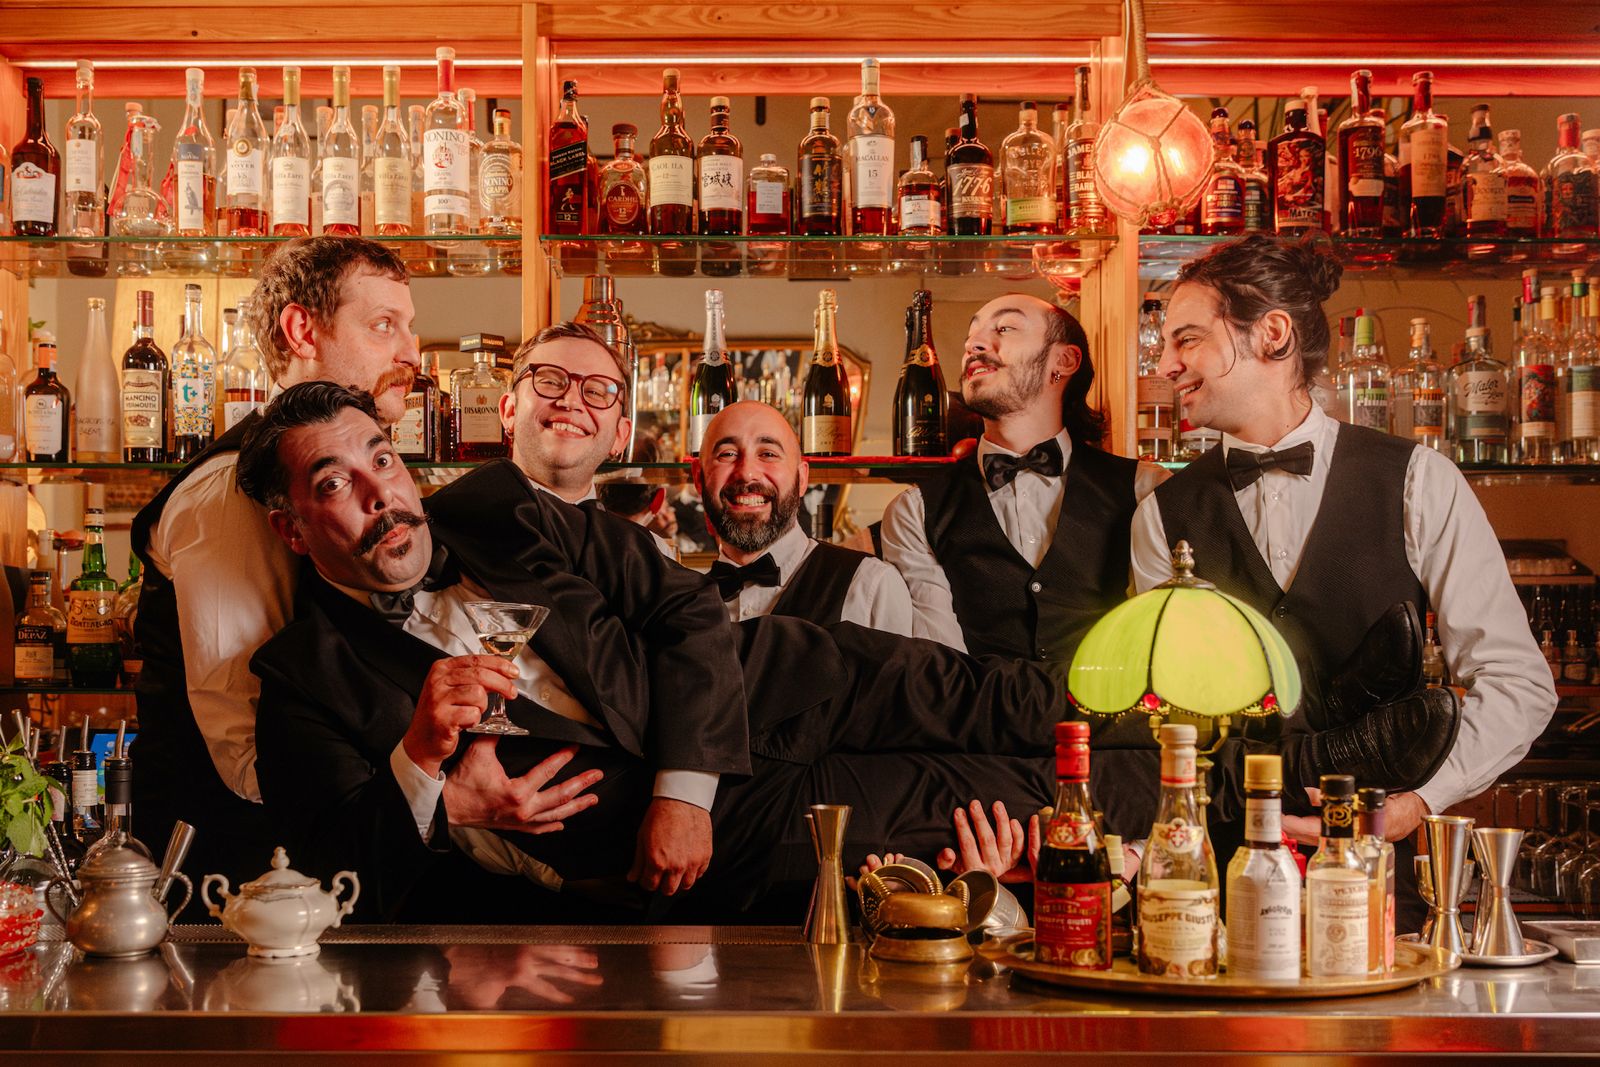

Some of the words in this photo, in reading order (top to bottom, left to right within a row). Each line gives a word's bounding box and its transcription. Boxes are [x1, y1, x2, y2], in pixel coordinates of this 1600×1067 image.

[568, 151, 586, 161] LABEL
[1067, 144, 1094, 158] JAMES
[868, 169, 878, 178] 15
[953, 176, 992, 196] 1776
[125, 394, 157, 402] MANCINO
[464, 406, 499, 415] DISARONNO
[18, 630, 47, 640] DEPAZ
[1066, 917, 1092, 926] GIUSTI
[1185, 911, 1213, 925] GIUSTI
